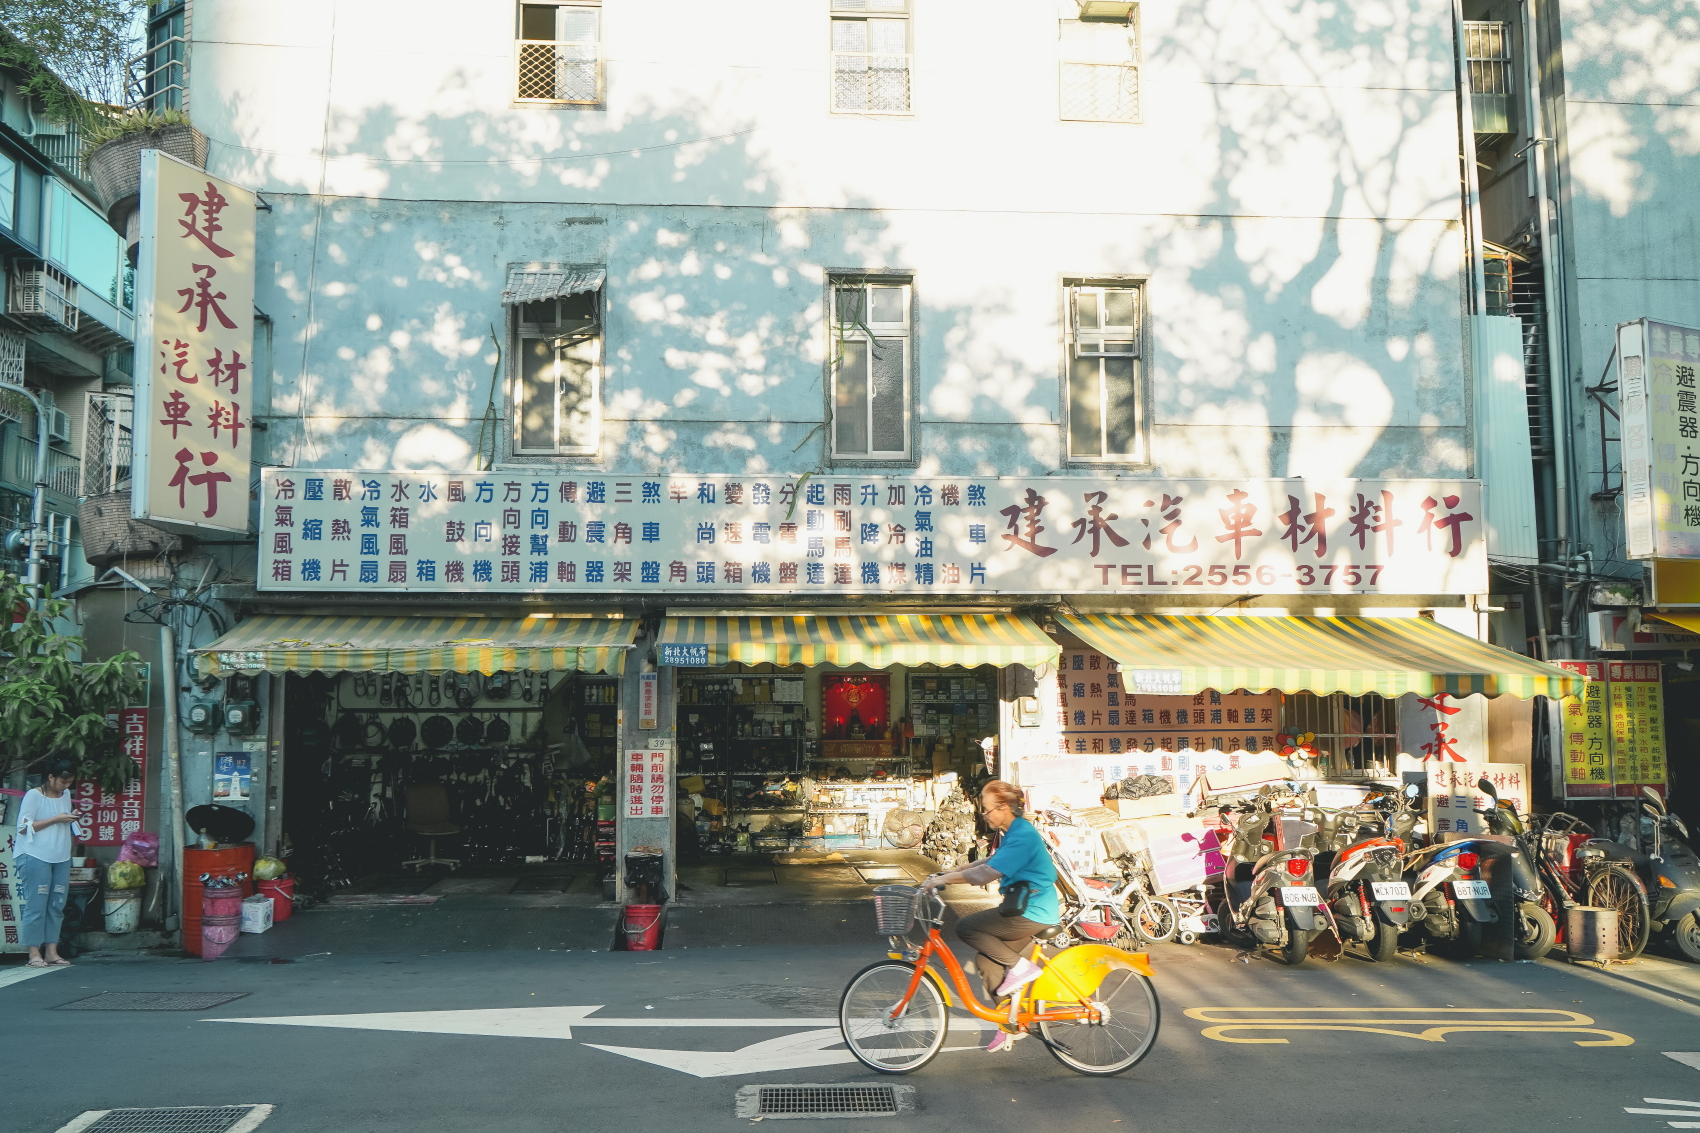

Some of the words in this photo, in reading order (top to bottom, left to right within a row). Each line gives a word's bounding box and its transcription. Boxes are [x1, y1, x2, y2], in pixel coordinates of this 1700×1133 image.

[177, 181, 238, 332] 建承
[160, 338, 198, 440] 汽車
[206, 347, 246, 449] 材料
[168, 448, 232, 518] 行
[272, 479, 295, 582] 冷氣風箱
[301, 479, 324, 582] 壓縮機
[330, 479, 352, 582] 散熱片
[359, 479, 382, 583] 冷氣風扇
[388, 480, 410, 583] 水箱風扇
[444, 481, 466, 583] 風鼓機
[472, 481, 495, 583] 方向機
[501, 481, 521, 584] 方向接頭
[529, 481, 550, 584] 方向幫浦
[557, 481, 578, 583] 傳動軸
[585, 481, 606, 583] 避震器
[612, 482, 633, 583] 三角架
[641, 482, 661, 583] 煞車盤
[696, 482, 716, 584] 和尚頭
[724, 482, 743, 584] 變速箱
[751, 483, 771, 584] 發電機
[806, 483, 825, 584] 起動馬達
[833, 483, 852, 584] 雨刷馬達
[1000, 488, 1473, 560] 建承汽車材料行
[860, 484, 880, 584] 升降機
[887, 484, 907, 584] 加冷煤
[914, 484, 934, 585] 冷氣油精
[940, 484, 960, 584] 機油
[967, 484, 987, 585] 煞車片
[1094, 564, 1384, 587] TEL:2556-3757
[664, 657, 706, 665] 28951080
[1073, 655, 1086, 725] 壓縮機
[1089, 655, 1102, 725] 散熱片
[1611, 665, 1658, 680] 專業服務
[121, 714, 144, 840] 吉祥車音響
[629, 753, 644, 816] 車輛隨時進出
[651, 753, 665, 816] 門前請勿停車
